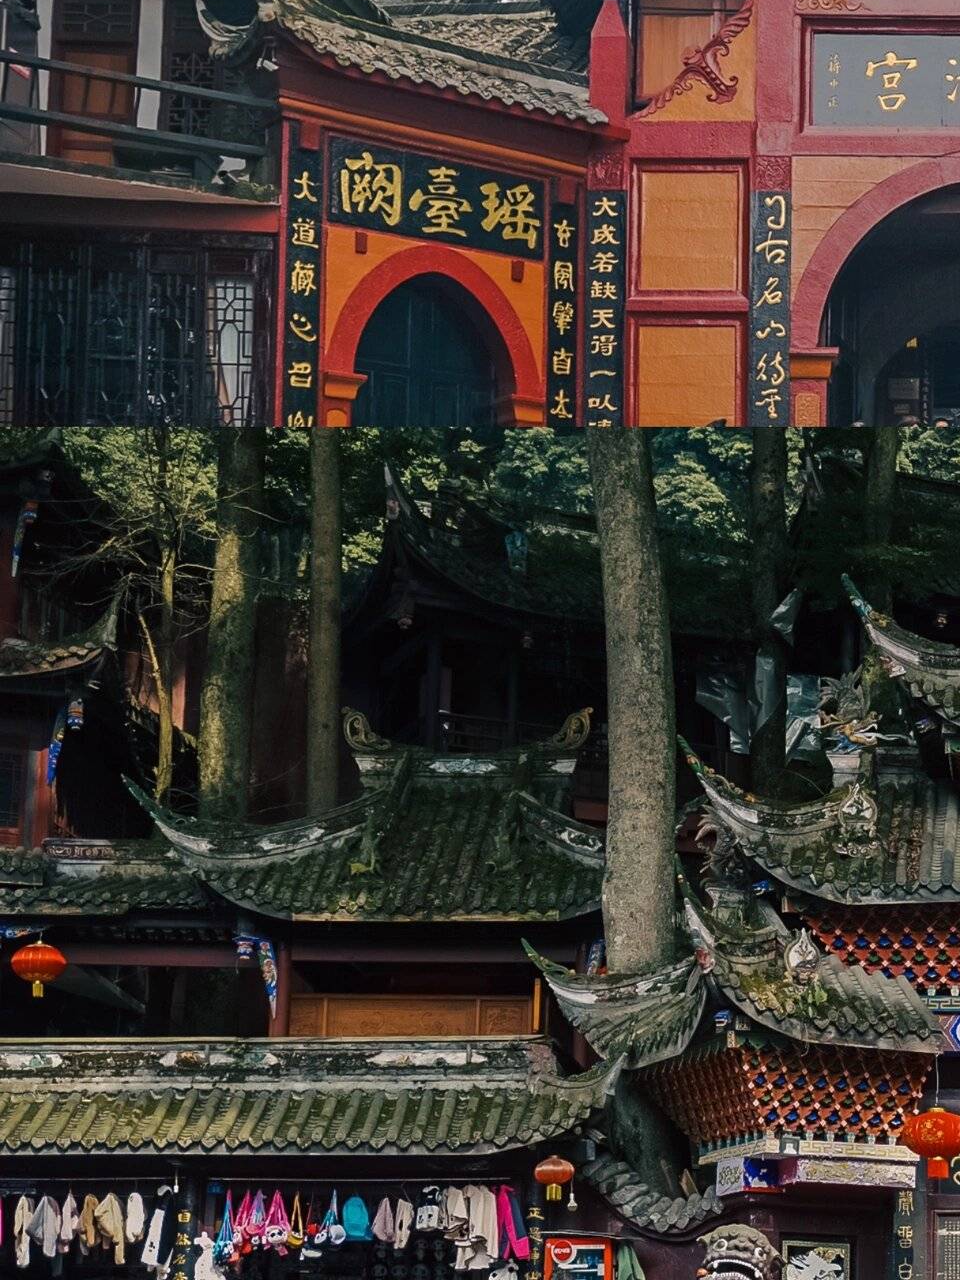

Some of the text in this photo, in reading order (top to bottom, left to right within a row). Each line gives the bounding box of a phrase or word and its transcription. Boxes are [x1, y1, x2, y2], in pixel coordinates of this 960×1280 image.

[587, 196, 621, 427] 大成若缺天得一以
